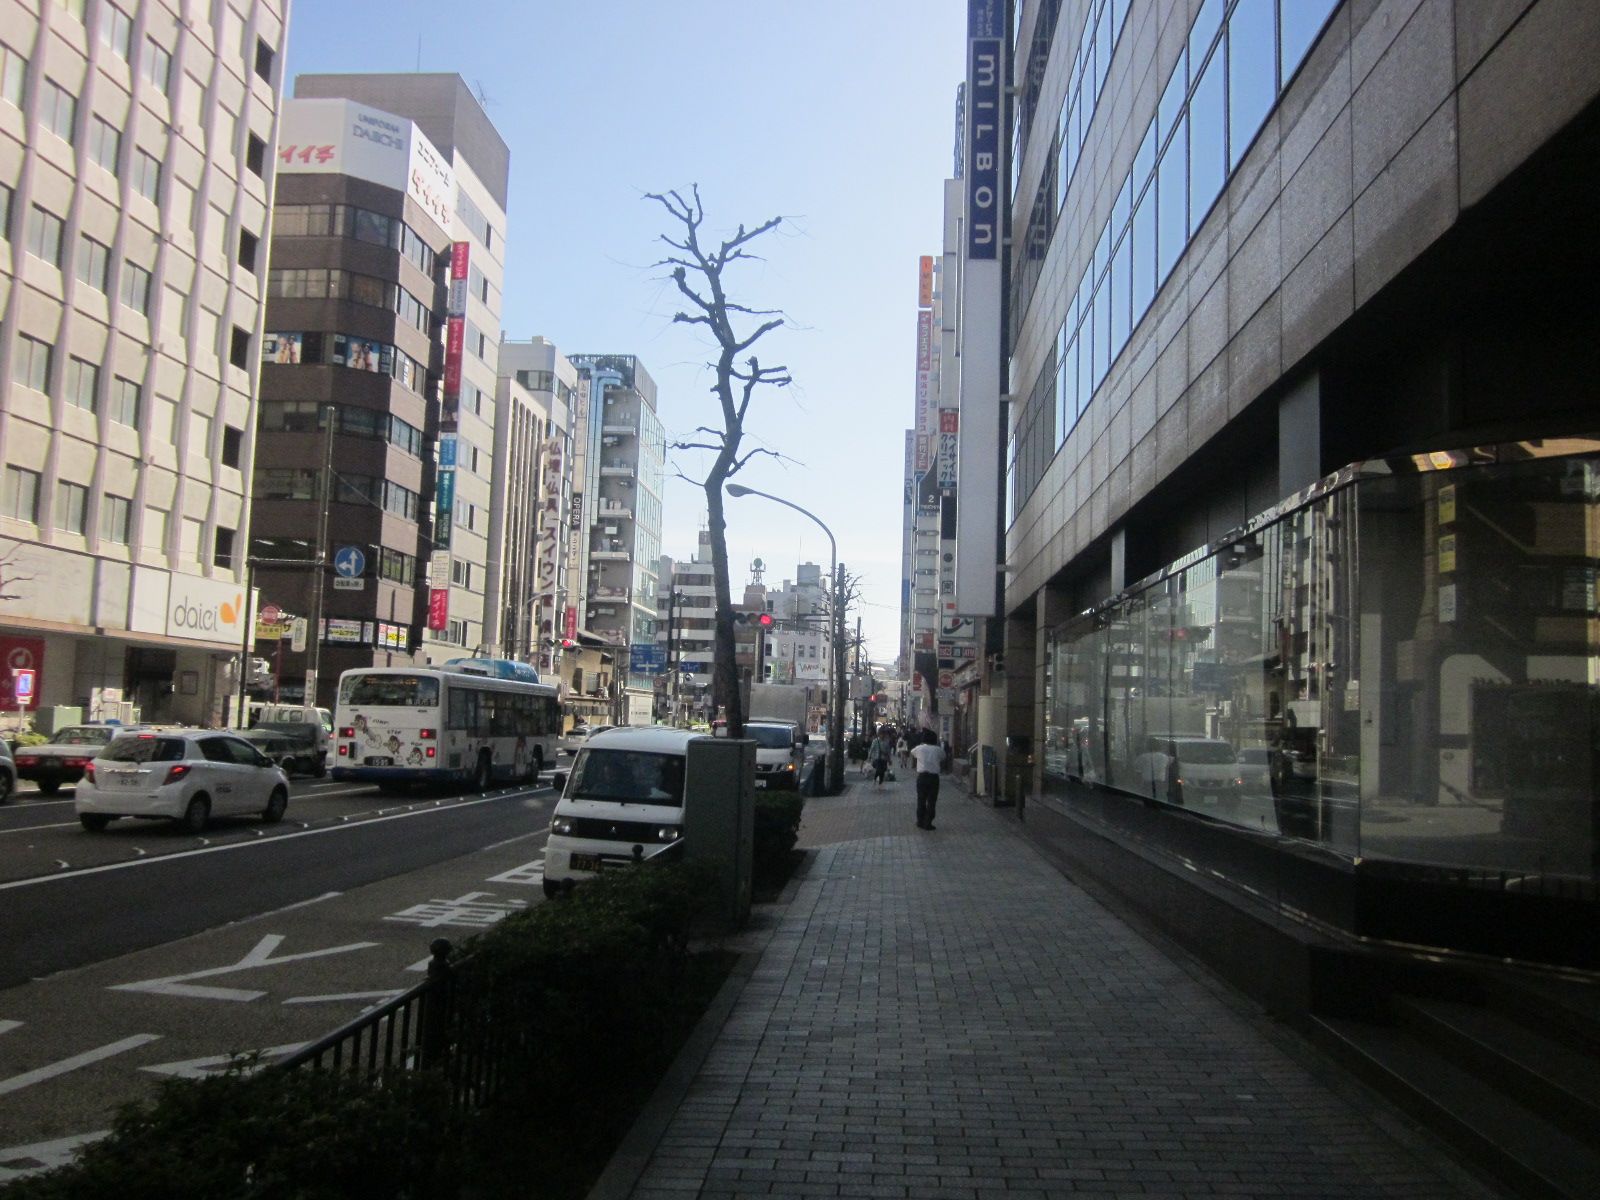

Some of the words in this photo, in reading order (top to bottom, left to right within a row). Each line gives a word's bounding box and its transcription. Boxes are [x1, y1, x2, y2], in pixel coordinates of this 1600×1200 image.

[940, 433, 949, 480] クリニック
[949, 433, 957, 480] ベイサイド
[573, 496, 581, 526] OPERA
